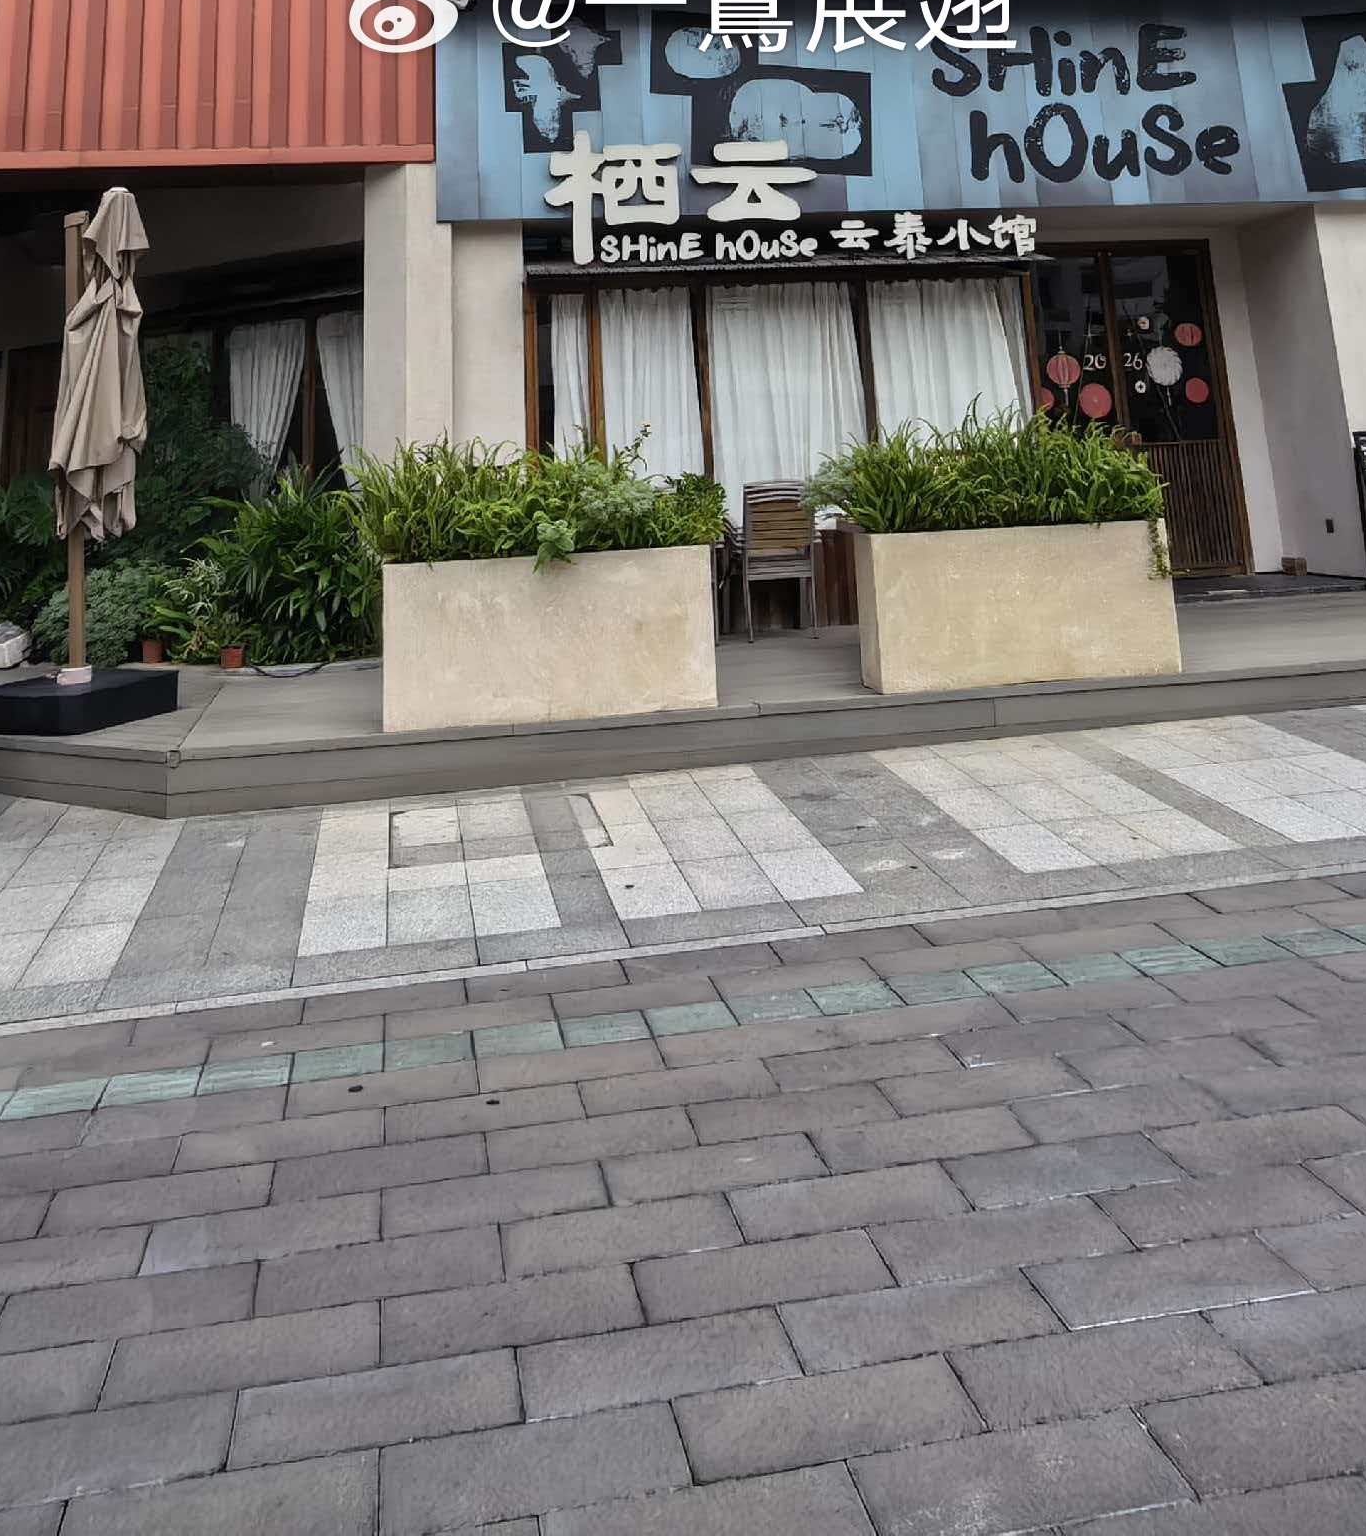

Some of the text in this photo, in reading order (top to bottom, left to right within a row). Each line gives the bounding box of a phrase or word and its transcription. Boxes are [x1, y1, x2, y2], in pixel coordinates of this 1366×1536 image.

[543, 129, 820, 265] 栖云
[829, 211, 1037, 260] 云泰小馆
